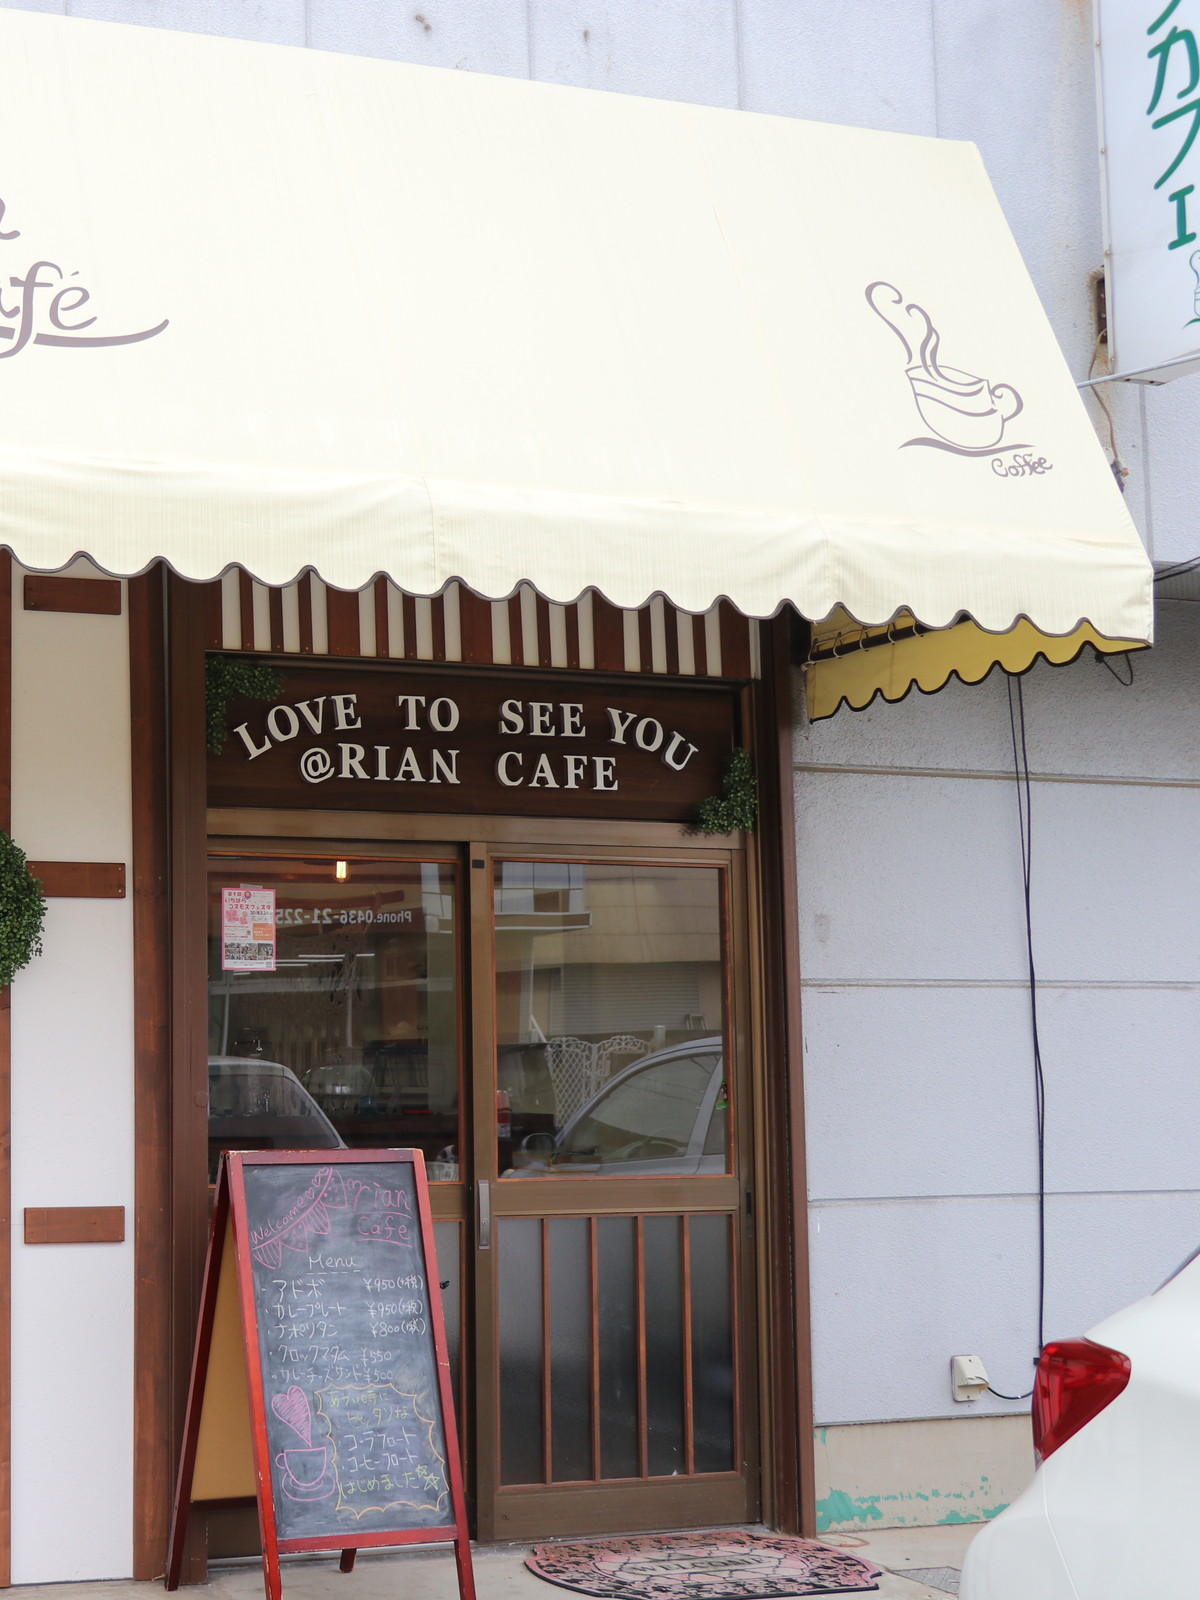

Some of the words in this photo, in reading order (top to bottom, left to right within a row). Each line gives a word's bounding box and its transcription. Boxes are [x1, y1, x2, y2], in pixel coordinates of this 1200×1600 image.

[991, 453, 1053, 477] Coffee
[234, 694, 362, 761] LOVE
[398, 695, 460, 732] TO
[499, 699, 587, 737] SEE
[606, 707, 699, 772] YOU
[300, 743, 461, 784] @RIAN
[496, 751, 619, 791] CAFE
[251, 1196, 307, 1244] Welcome
[357, 1215, 411, 1240] Cafe
[309, 1253, 360, 1270] Menu
[272, 1279, 325, 1302] アドボ
[273, 1302, 347, 1320] カレープレート
[275, 1321, 337, 1339] ナポリタン
